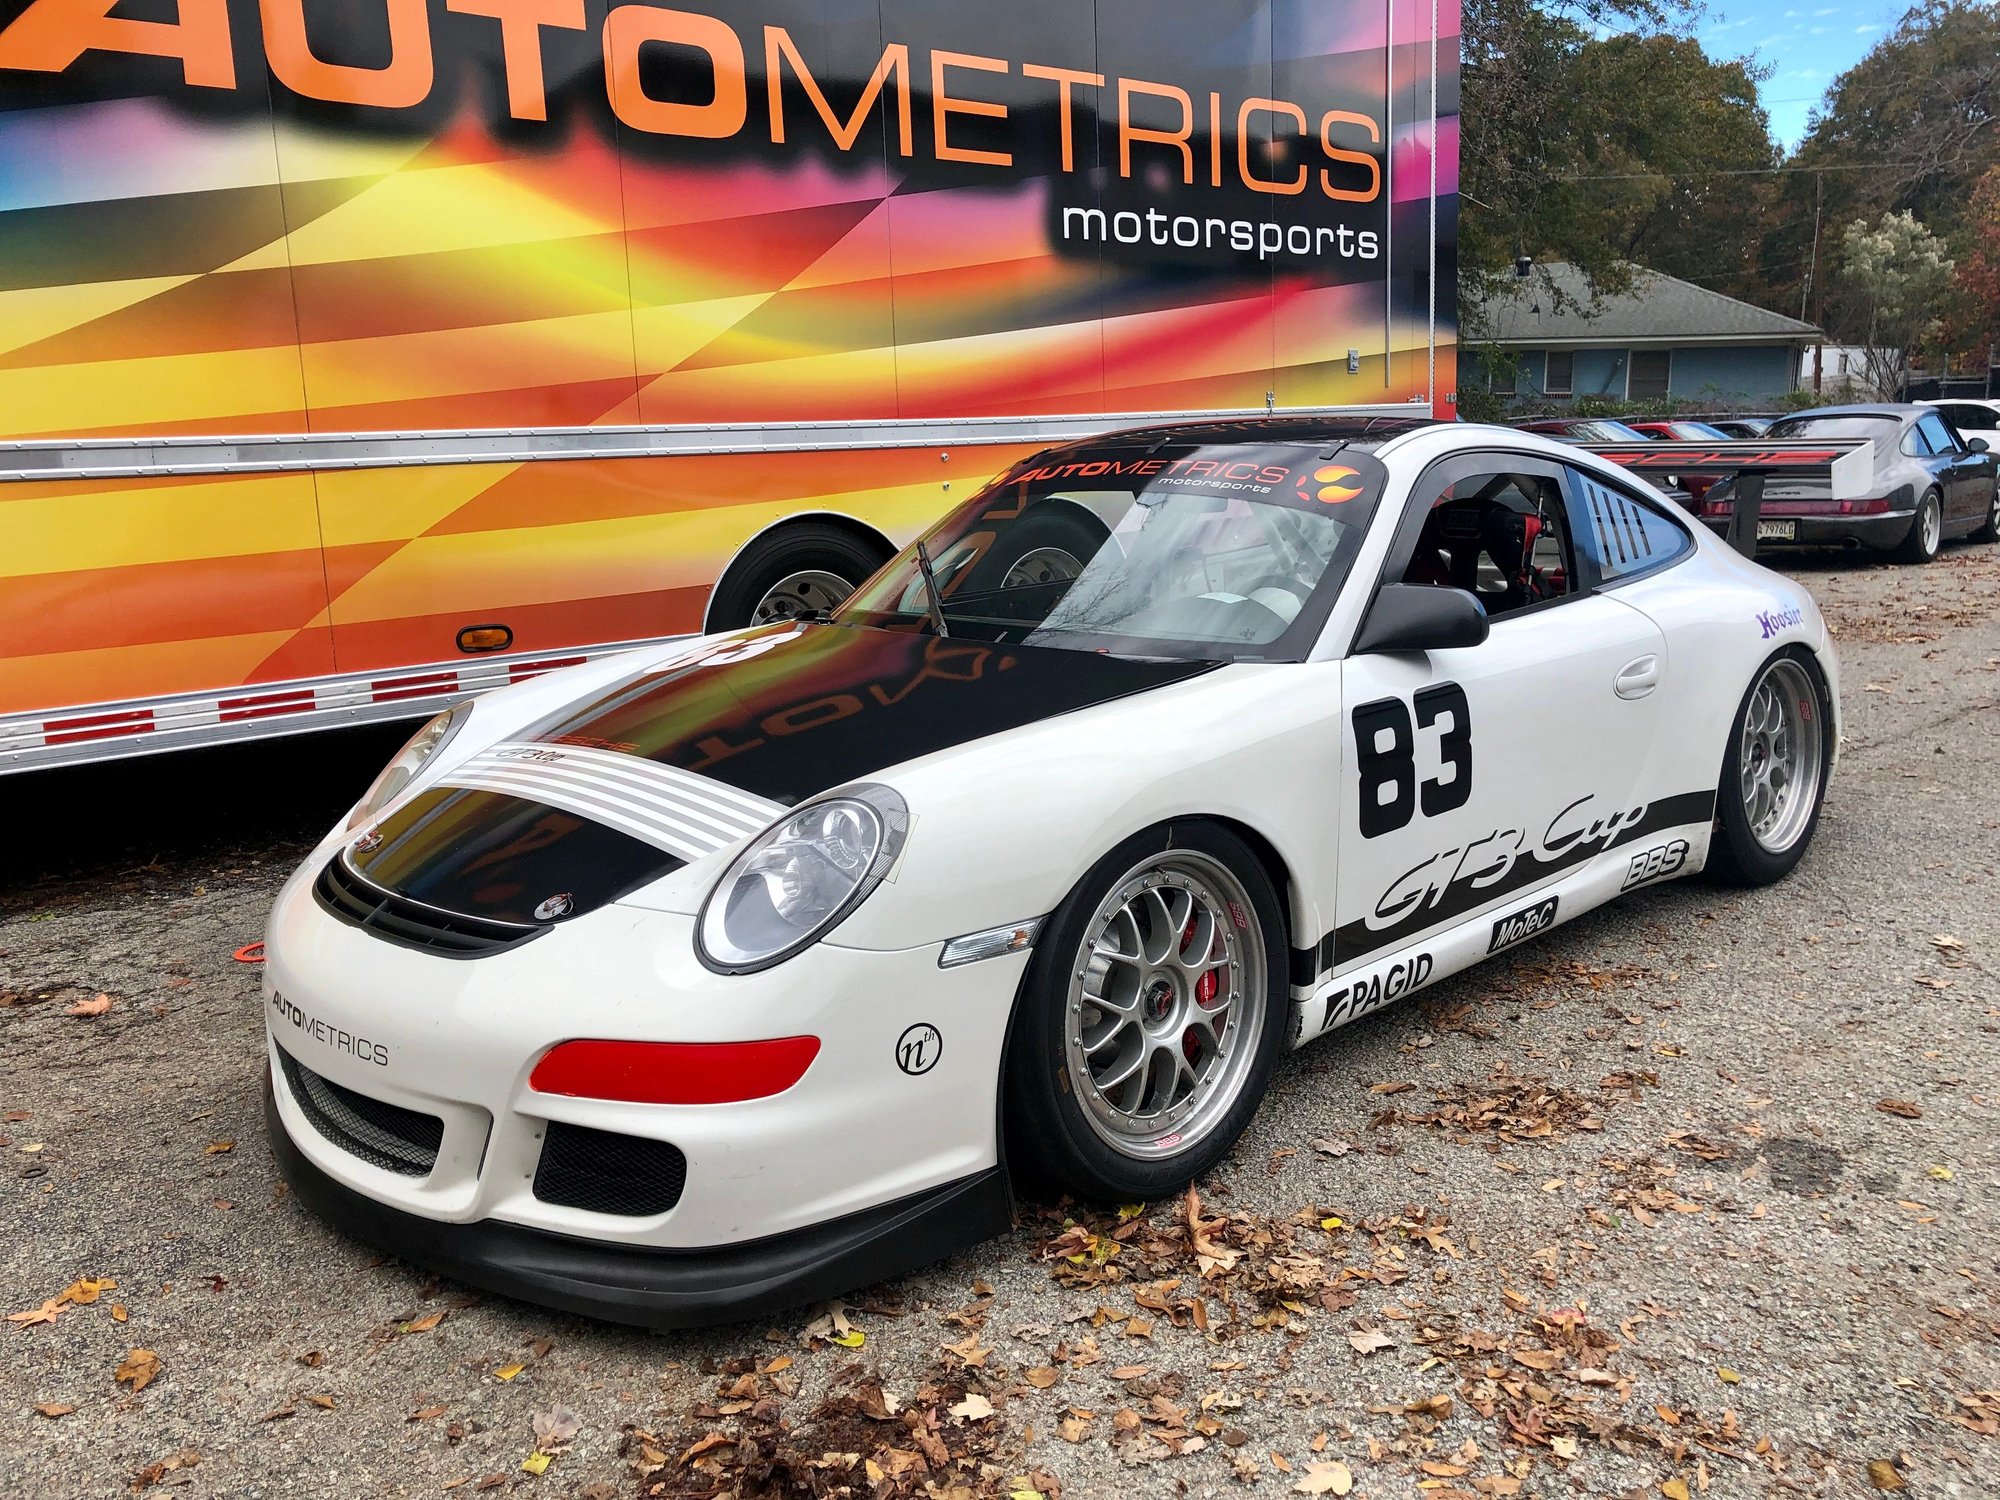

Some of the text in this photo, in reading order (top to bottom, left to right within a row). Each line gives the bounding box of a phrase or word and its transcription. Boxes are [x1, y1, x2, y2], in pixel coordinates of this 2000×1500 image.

[0, 0, 1381, 203] AUTOMETRICS
[1063, 207, 1378, 260] motorsports
[1006, 459, 1291, 486] AUTOMETRICS
[1158, 477, 1272, 494] motorsports
[1765, 523, 1794, 536] 7976LG
[1756, 604, 1803, 639] Hoosier
[643, 632, 803, 674] 83
[1352, 680, 1473, 840] 83
[1364, 793, 1649, 931] GT3 Cup
[1620, 839, 1690, 893] BBS
[1494, 901, 1557, 950] MoTeC
[1347, 953, 1434, 1018] PAGID
[273, 990, 389, 1067] AUTOMETRICS
